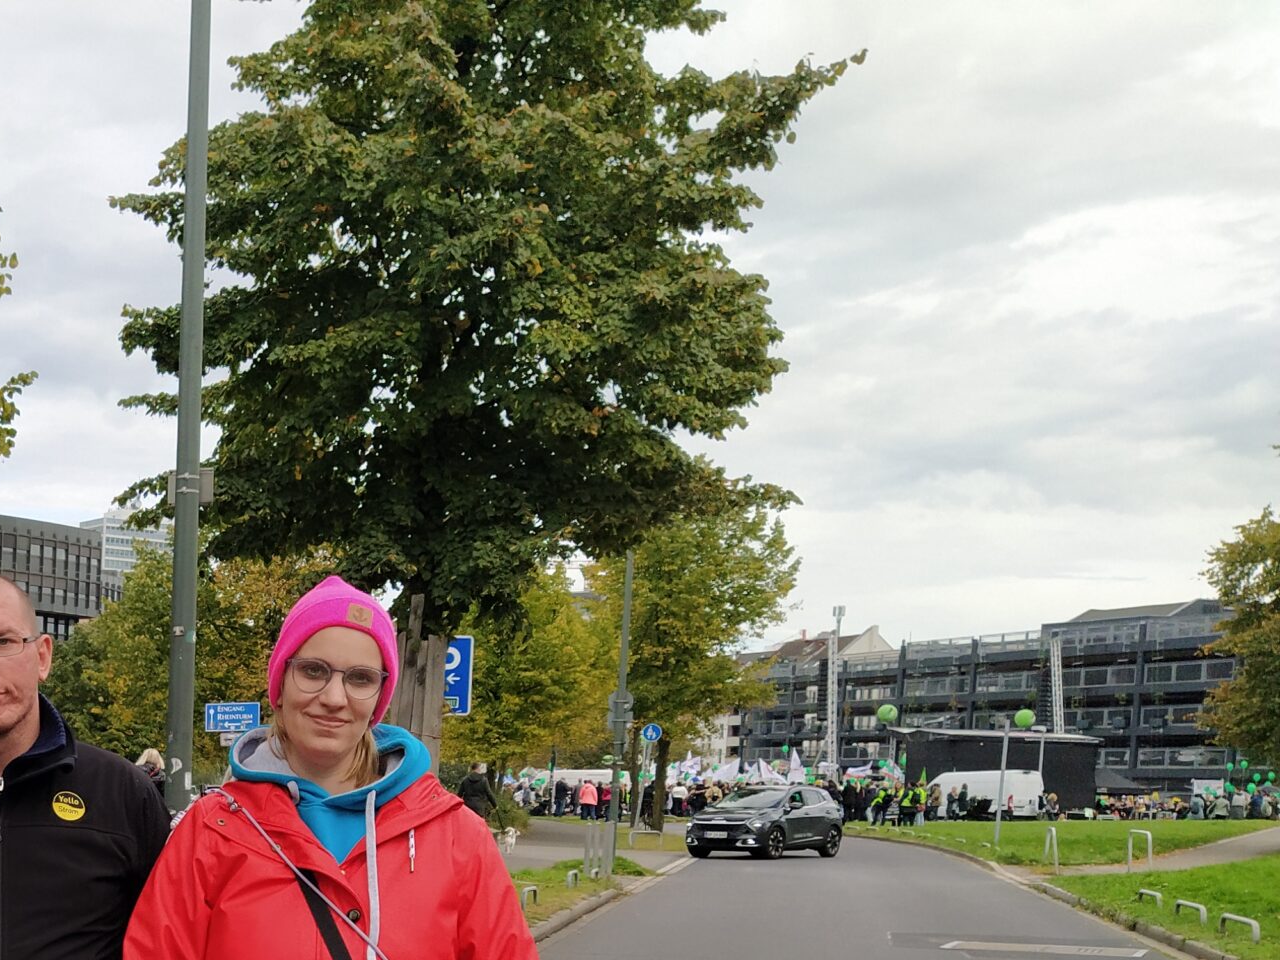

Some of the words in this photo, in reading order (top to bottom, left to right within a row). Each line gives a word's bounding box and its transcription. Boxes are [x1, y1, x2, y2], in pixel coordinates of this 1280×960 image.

[217, 713, 253, 721] RHEINTURM
[58, 795, 79, 806] Yello
[58, 805, 79, 816] Strom
